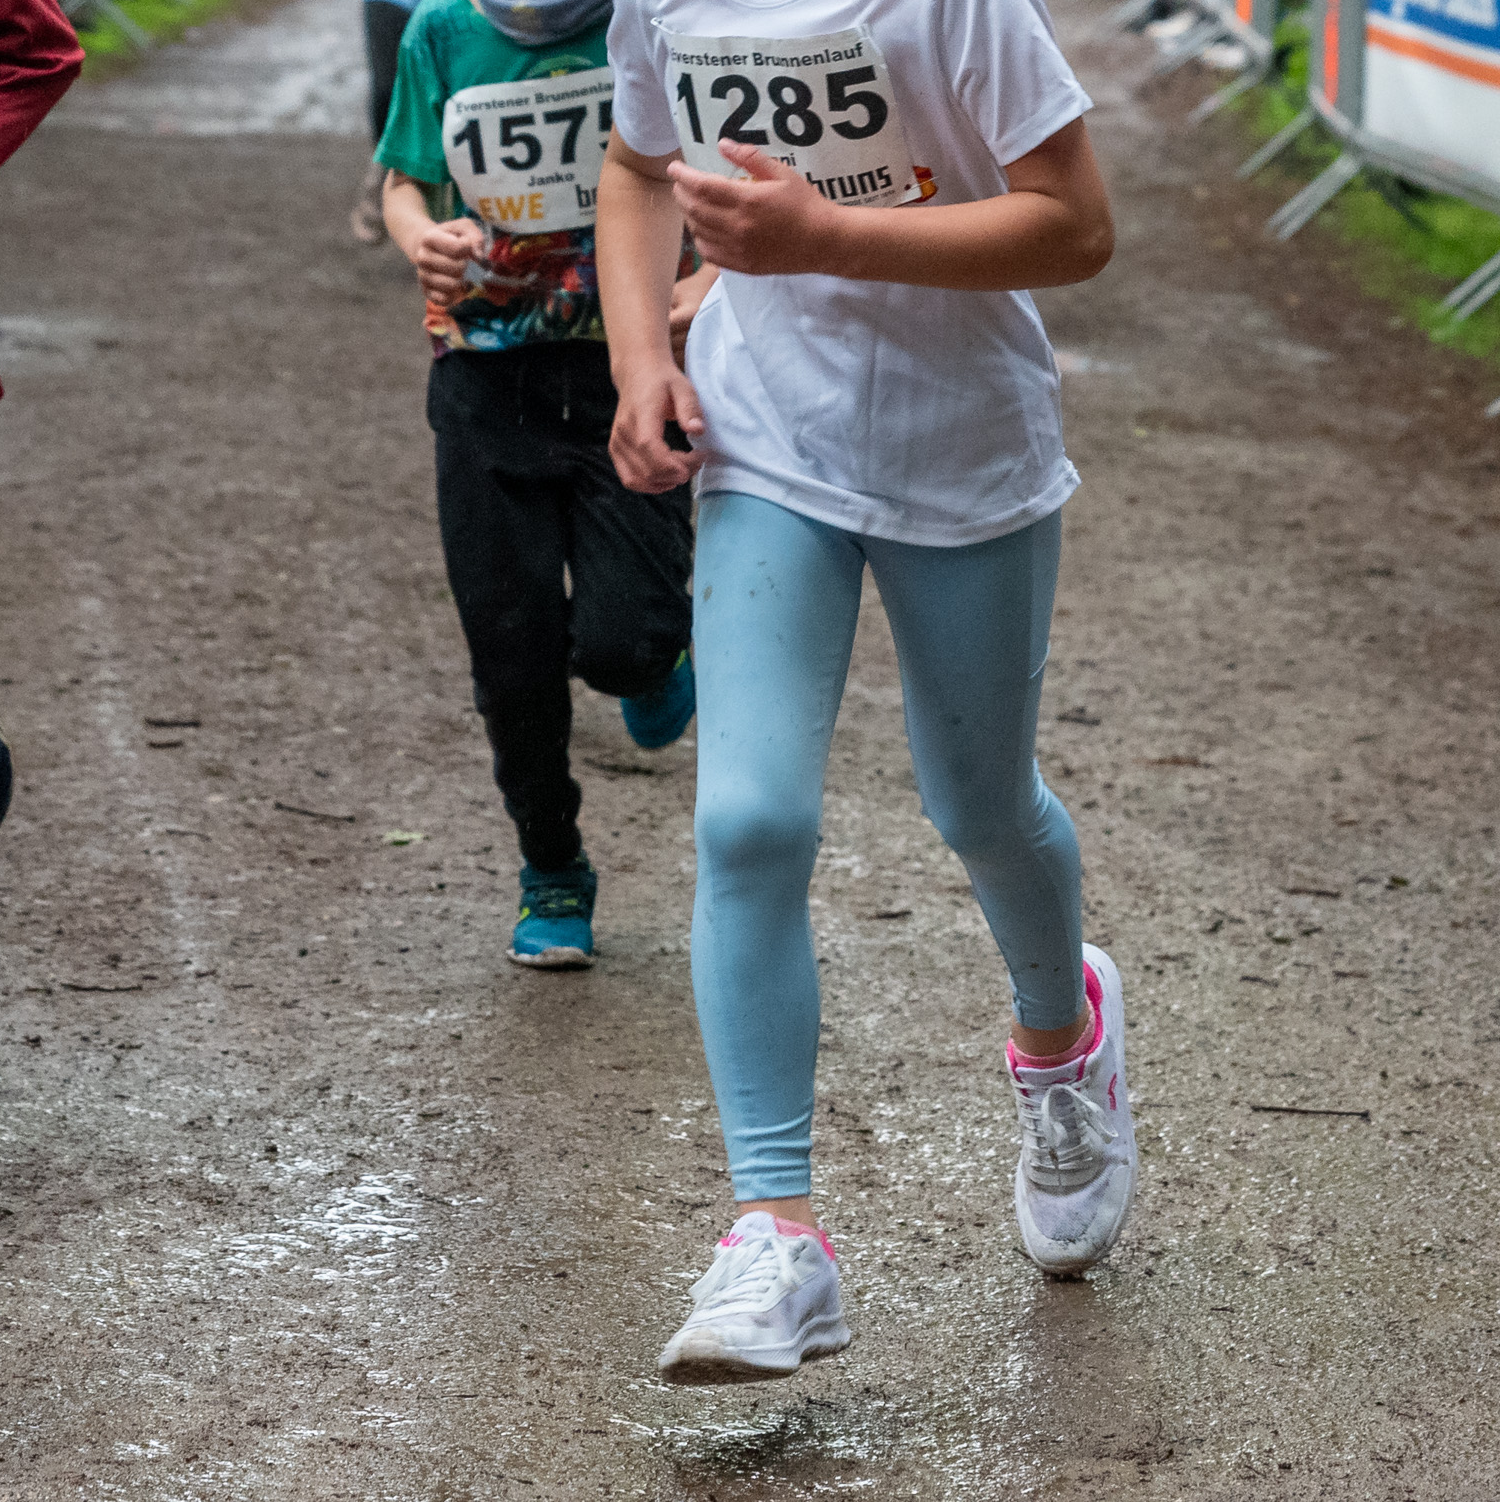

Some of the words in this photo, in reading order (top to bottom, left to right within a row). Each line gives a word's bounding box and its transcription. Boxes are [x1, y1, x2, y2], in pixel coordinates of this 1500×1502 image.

[752, 42, 864, 68] Brunnenlauf
[456, 97, 531, 114] Everstener
[676, 64, 889, 147] 1285
[528, 172, 575, 187] Janko
[478, 192, 544, 221] EWE
